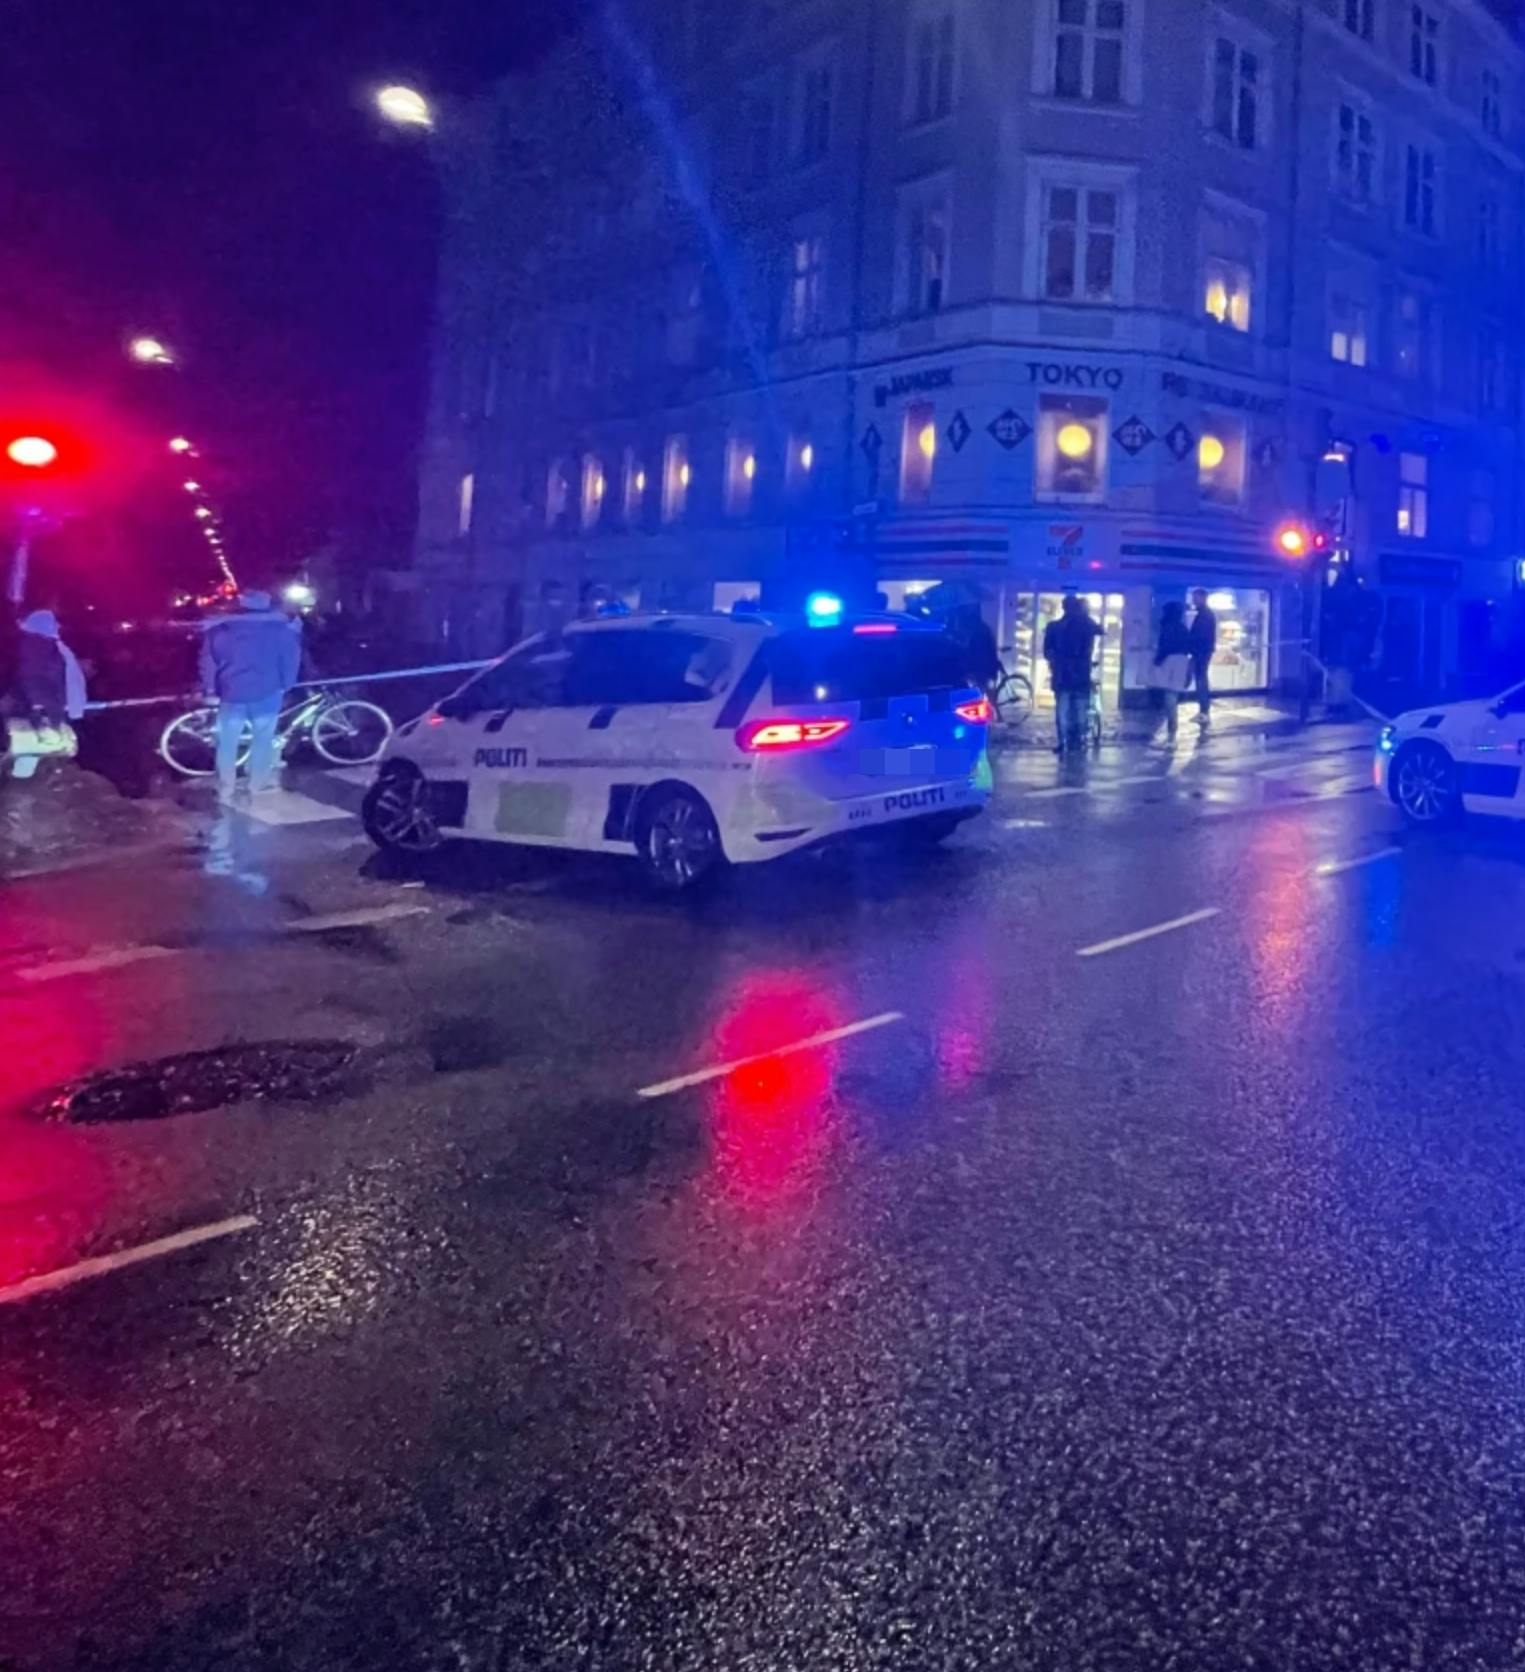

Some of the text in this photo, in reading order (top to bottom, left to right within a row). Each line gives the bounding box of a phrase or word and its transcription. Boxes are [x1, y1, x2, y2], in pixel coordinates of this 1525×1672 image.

[1024, 361, 1123, 391] TOKYO
[474, 747, 527, 768] POLITI
[883, 786, 945, 812] POLITI
